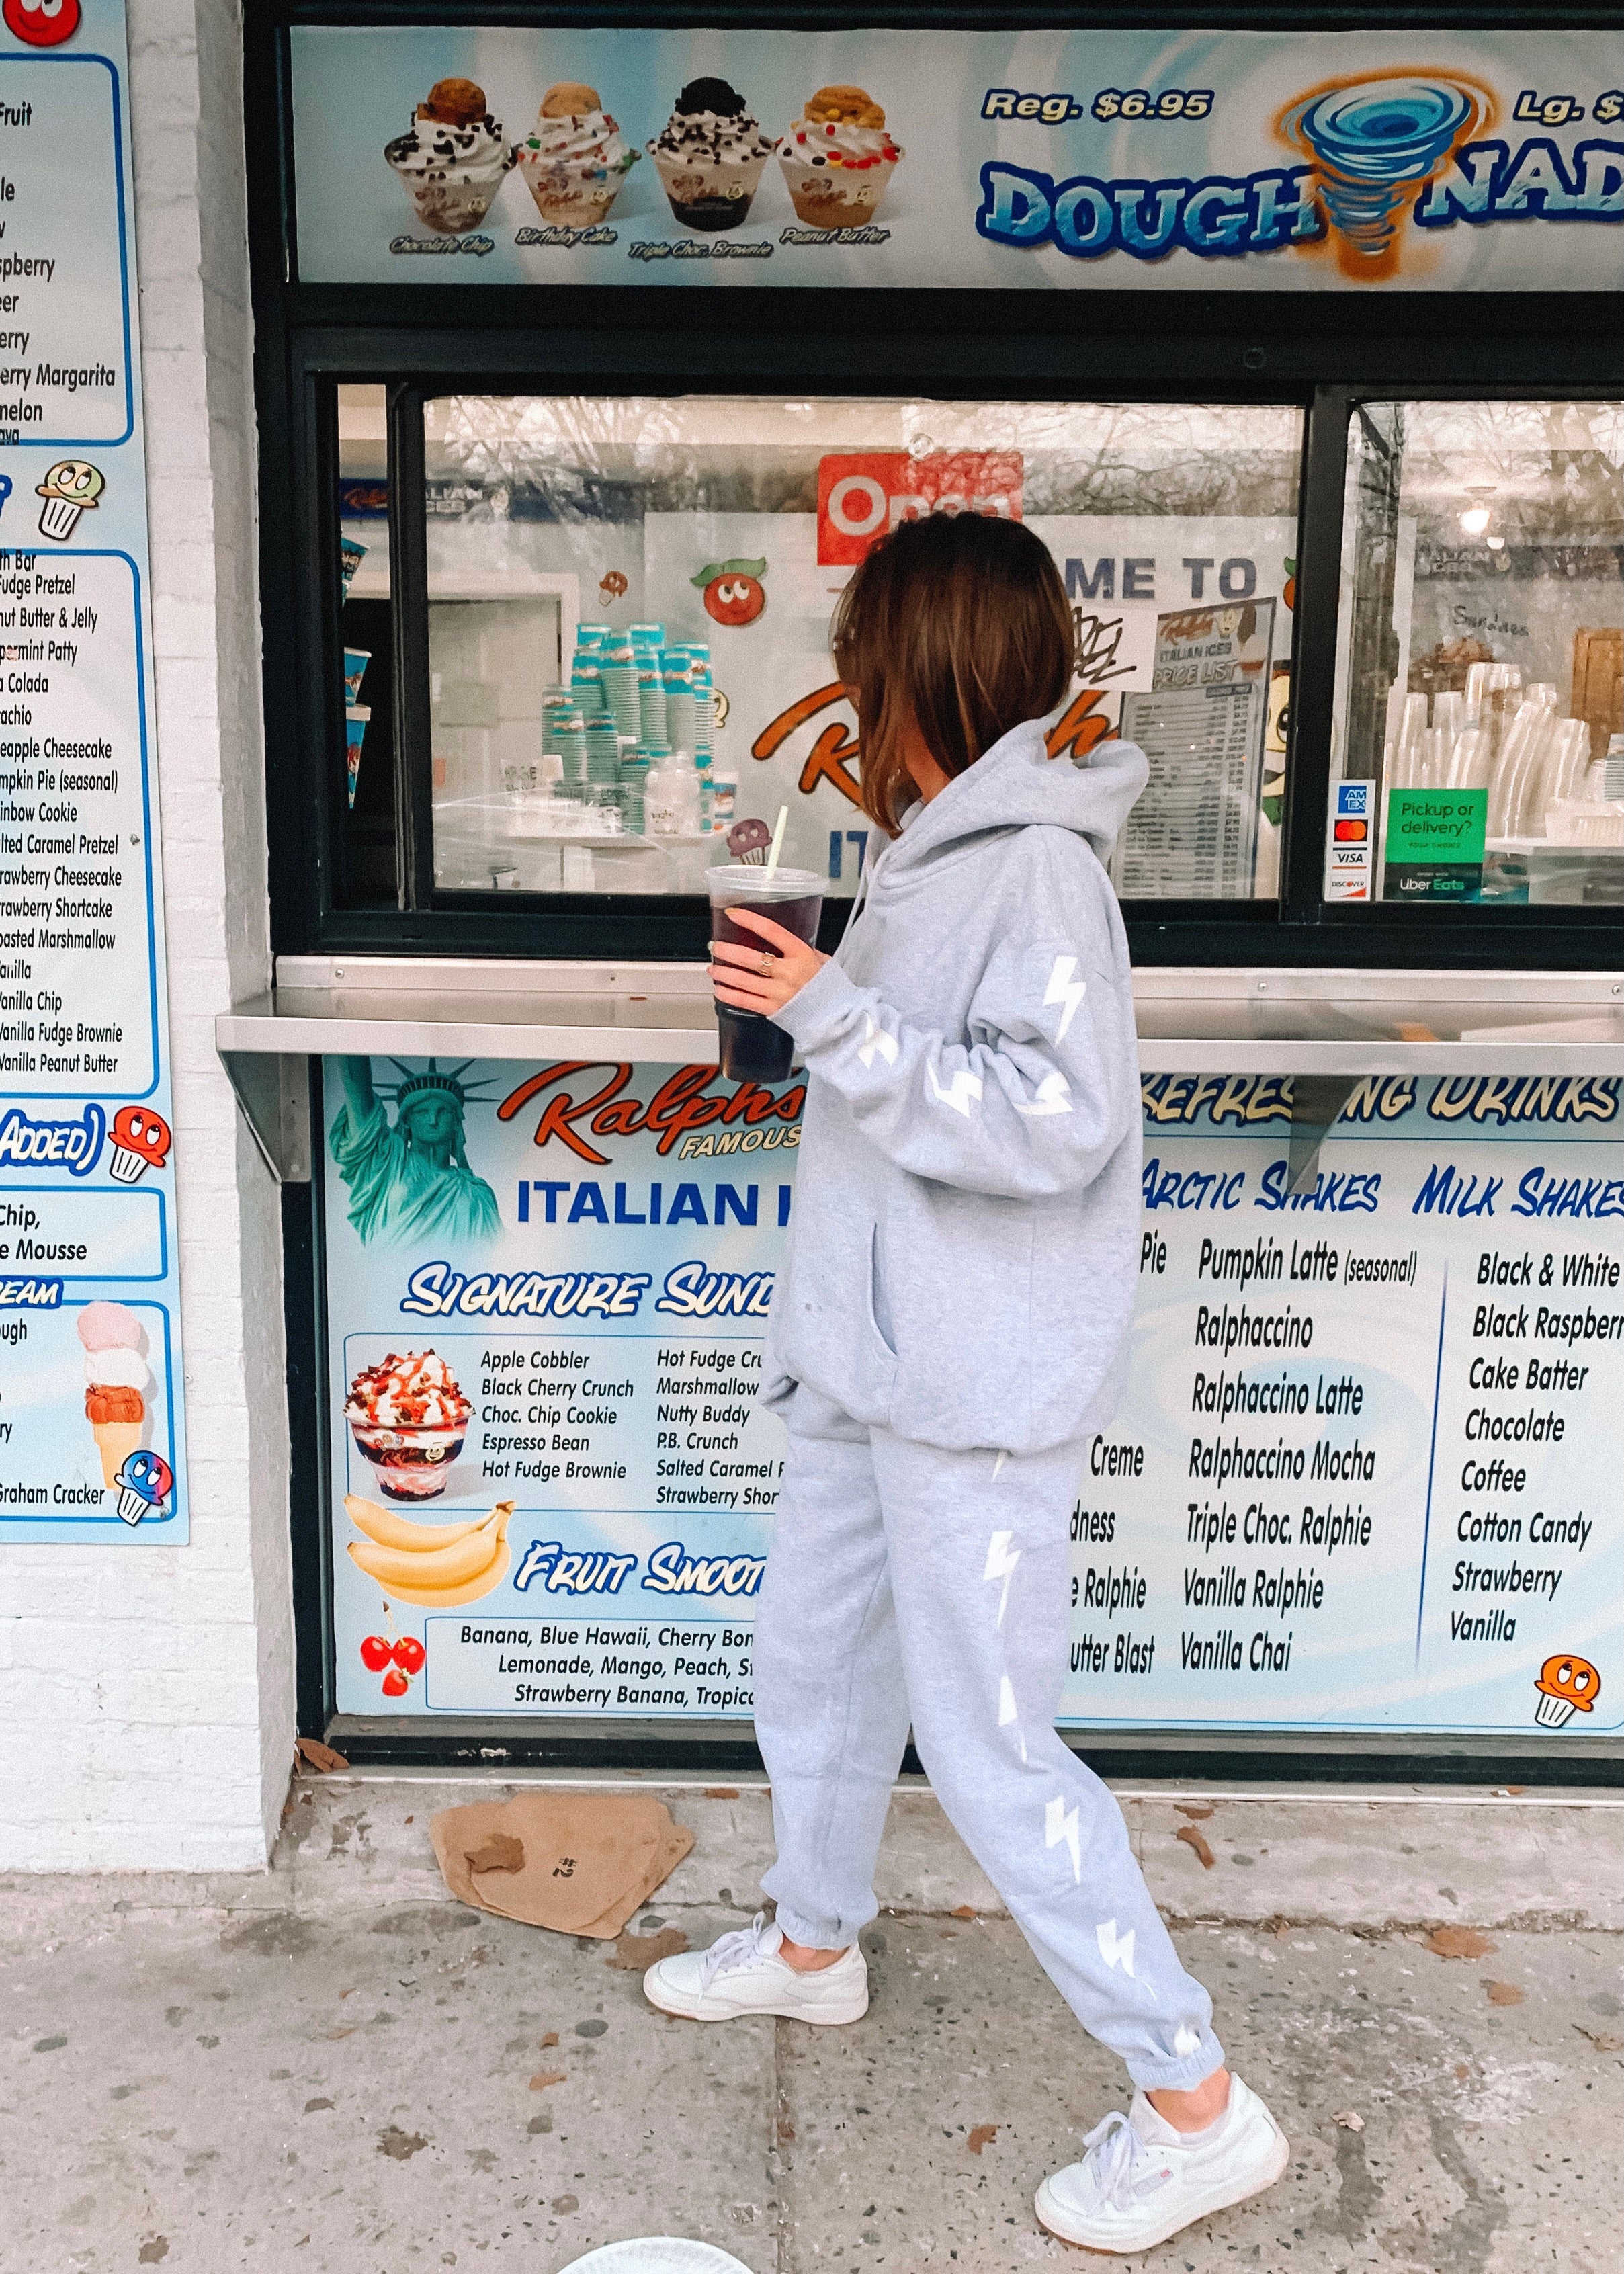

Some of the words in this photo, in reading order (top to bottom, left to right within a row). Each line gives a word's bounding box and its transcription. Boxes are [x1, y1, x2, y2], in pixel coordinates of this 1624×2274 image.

[982, 89, 1080, 123] Reg.
[1093, 89, 1213, 123] $6.95
[1514, 91, 1585, 126] Lg.
[976, 163, 1328, 257] DOUGH
[390, 236, 460, 254] Chocolate
[461, 236, 494, 255] Chip
[516, 226, 579, 247] Birthday
[581, 228, 617, 245] Cake
[780, 228, 837, 244] Peanut
[838, 227, 890, 244] Butter
[629, 242, 671, 261] Triple
[711, 241, 773, 258] Brownie
[36, 363, 115, 392] Margarita
[15, 549, 36, 571] Bar
[36, 573, 75, 595] Pretzel
[1183, 558, 1256, 599] TO
[20, 607, 55, 628] Butter
[59, 607, 68, 628] &
[71, 607, 97, 634] Jelly
[48, 640, 77, 666] Patty
[9, 672, 48, 693] Colada
[44, 738, 112, 758] Cheesecake
[38, 769, 55, 790] Pie
[60, 769, 118, 793] (seasonal)
[38, 801, 77, 822] Cookie
[1402, 802, 1454, 819] Pickup
[1457, 806, 1475, 816] or
[1401, 820, 1472, 837] delivery?
[27, 833, 75, 854] Caramel
[79, 834, 118, 854] Pretzel
[1338, 853, 1363, 863] VISA
[54, 866, 122, 886] Cheesecake
[1400, 878, 1432, 890] Uber
[1433, 878, 1465, 890] Eats
[56, 897, 112, 918] Shortcake
[38, 928, 116, 949] Marshmallow
[37, 990, 62, 1015] Chip
[38, 1021, 73, 1046] Fudge
[77, 1022, 122, 1042] Brownie
[40, 1053, 80, 1072] Peanut
[84, 1054, 118, 1072] Butter
[1426, 1077, 1623, 1125] DRINKS
[679, 1124, 802, 1160] FAMOUS
[1142, 1158, 1245, 1210] ARCTIC
[1411, 1164, 1503, 1217] MILK
[517, 1180, 757, 1226] ITALIAN
[16, 1239, 87, 1260] Mousse
[1141, 1229, 1167, 1274] Pie
[1199, 1237, 1283, 1291] Pumpkin
[1290, 1240, 1338, 1281] Latte
[1344, 1250, 1417, 1286] (seasonal)
[1477, 1251, 1533, 1286] Black
[1539, 1253, 1554, 1286] &
[1562, 1253, 1620, 1287] White
[400, 1261, 652, 1318] SIGNATURE
[1195, 1304, 1313, 1357] Ralphaccino
[1473, 1304, 1529, 1338] Black
[481, 1351, 524, 1372] Apple
[531, 1351, 589, 1369] Cobbler
[658, 1349, 684, 1367] Hot
[691, 1350, 735, 1372] Fudge
[1469, 1356, 1519, 1390] Cake
[1525, 1359, 1589, 1390] Batter
[482, 1378, 521, 1396] Black
[528, 1379, 576, 1400] Cherry
[583, 1380, 634, 1396] Crunch
[657, 1377, 759, 1396] Marshmallow
[1192, 1370, 1308, 1423] Ralphaccino
[1315, 1374, 1363, 1416] Latte
[482, 1406, 521, 1423] Choc.
[528, 1406, 561, 1428] Chip
[567, 1406, 617, 1424] Cookie
[658, 1404, 697, 1426] Nutty
[703, 1405, 750, 1427] Buddy
[1465, 1407, 1565, 1441] Chocolate
[482, 1434, 545, 1454] Espresso
[552, 1434, 589, 1451] Bean
[658, 1432, 680, 1449] P.B.
[687, 1432, 738, 1450] Crunch
[1091, 1434, 1144, 1477] Creme
[1189, 1437, 1305, 1489] Ralphaccino
[1310, 1439, 1375, 1481] Mocha
[482, 1461, 509, 1478] Hot
[515, 1461, 560, 1482] Fudge
[566, 1462, 626, 1479] Brownie
[657, 1459, 703, 1477] Salted
[710, 1460, 773, 1478] Caramel
[1461, 1459, 1526, 1492] Coffee
[53, 1484, 105, 1504] Cracker
[657, 1486, 738, 1509] Strawberry
[1187, 1501, 1236, 1554] Triple
[1244, 1503, 1292, 1544] Choc.
[1300, 1504, 1371, 1556] Ralphie
[1457, 1511, 1522, 1542] Cotton
[1529, 1511, 1592, 1552] Candy
[513, 1540, 638, 1595] FRUIT
[1084, 1566, 1146, 1619] Ralphie
[1185, 1566, 1246, 1607] Vanilla
[1252, 1567, 1324, 1619] Ralphie
[1452, 1560, 1562, 1601] Strawberry
[1451, 1609, 1516, 1641] Vanilla
[460, 1626, 533, 1646] Banana,
[540, 1627, 579, 1645] Blue
[585, 1628, 651, 1649] Hawaii,
[658, 1628, 716, 1651] Cherry
[1181, 1630, 1242, 1671] Vanilla
[1249, 1632, 1293, 1672] Chai
[1114, 1632, 1155, 1674] Blast
[499, 1655, 594, 1677] Lemonade,
[601, 1657, 666, 1679] Mango,
[675, 1657, 731, 1679] Peach,
[515, 1684, 611, 1708] Strawberry
[617, 1687, 689, 1708] Banana,
